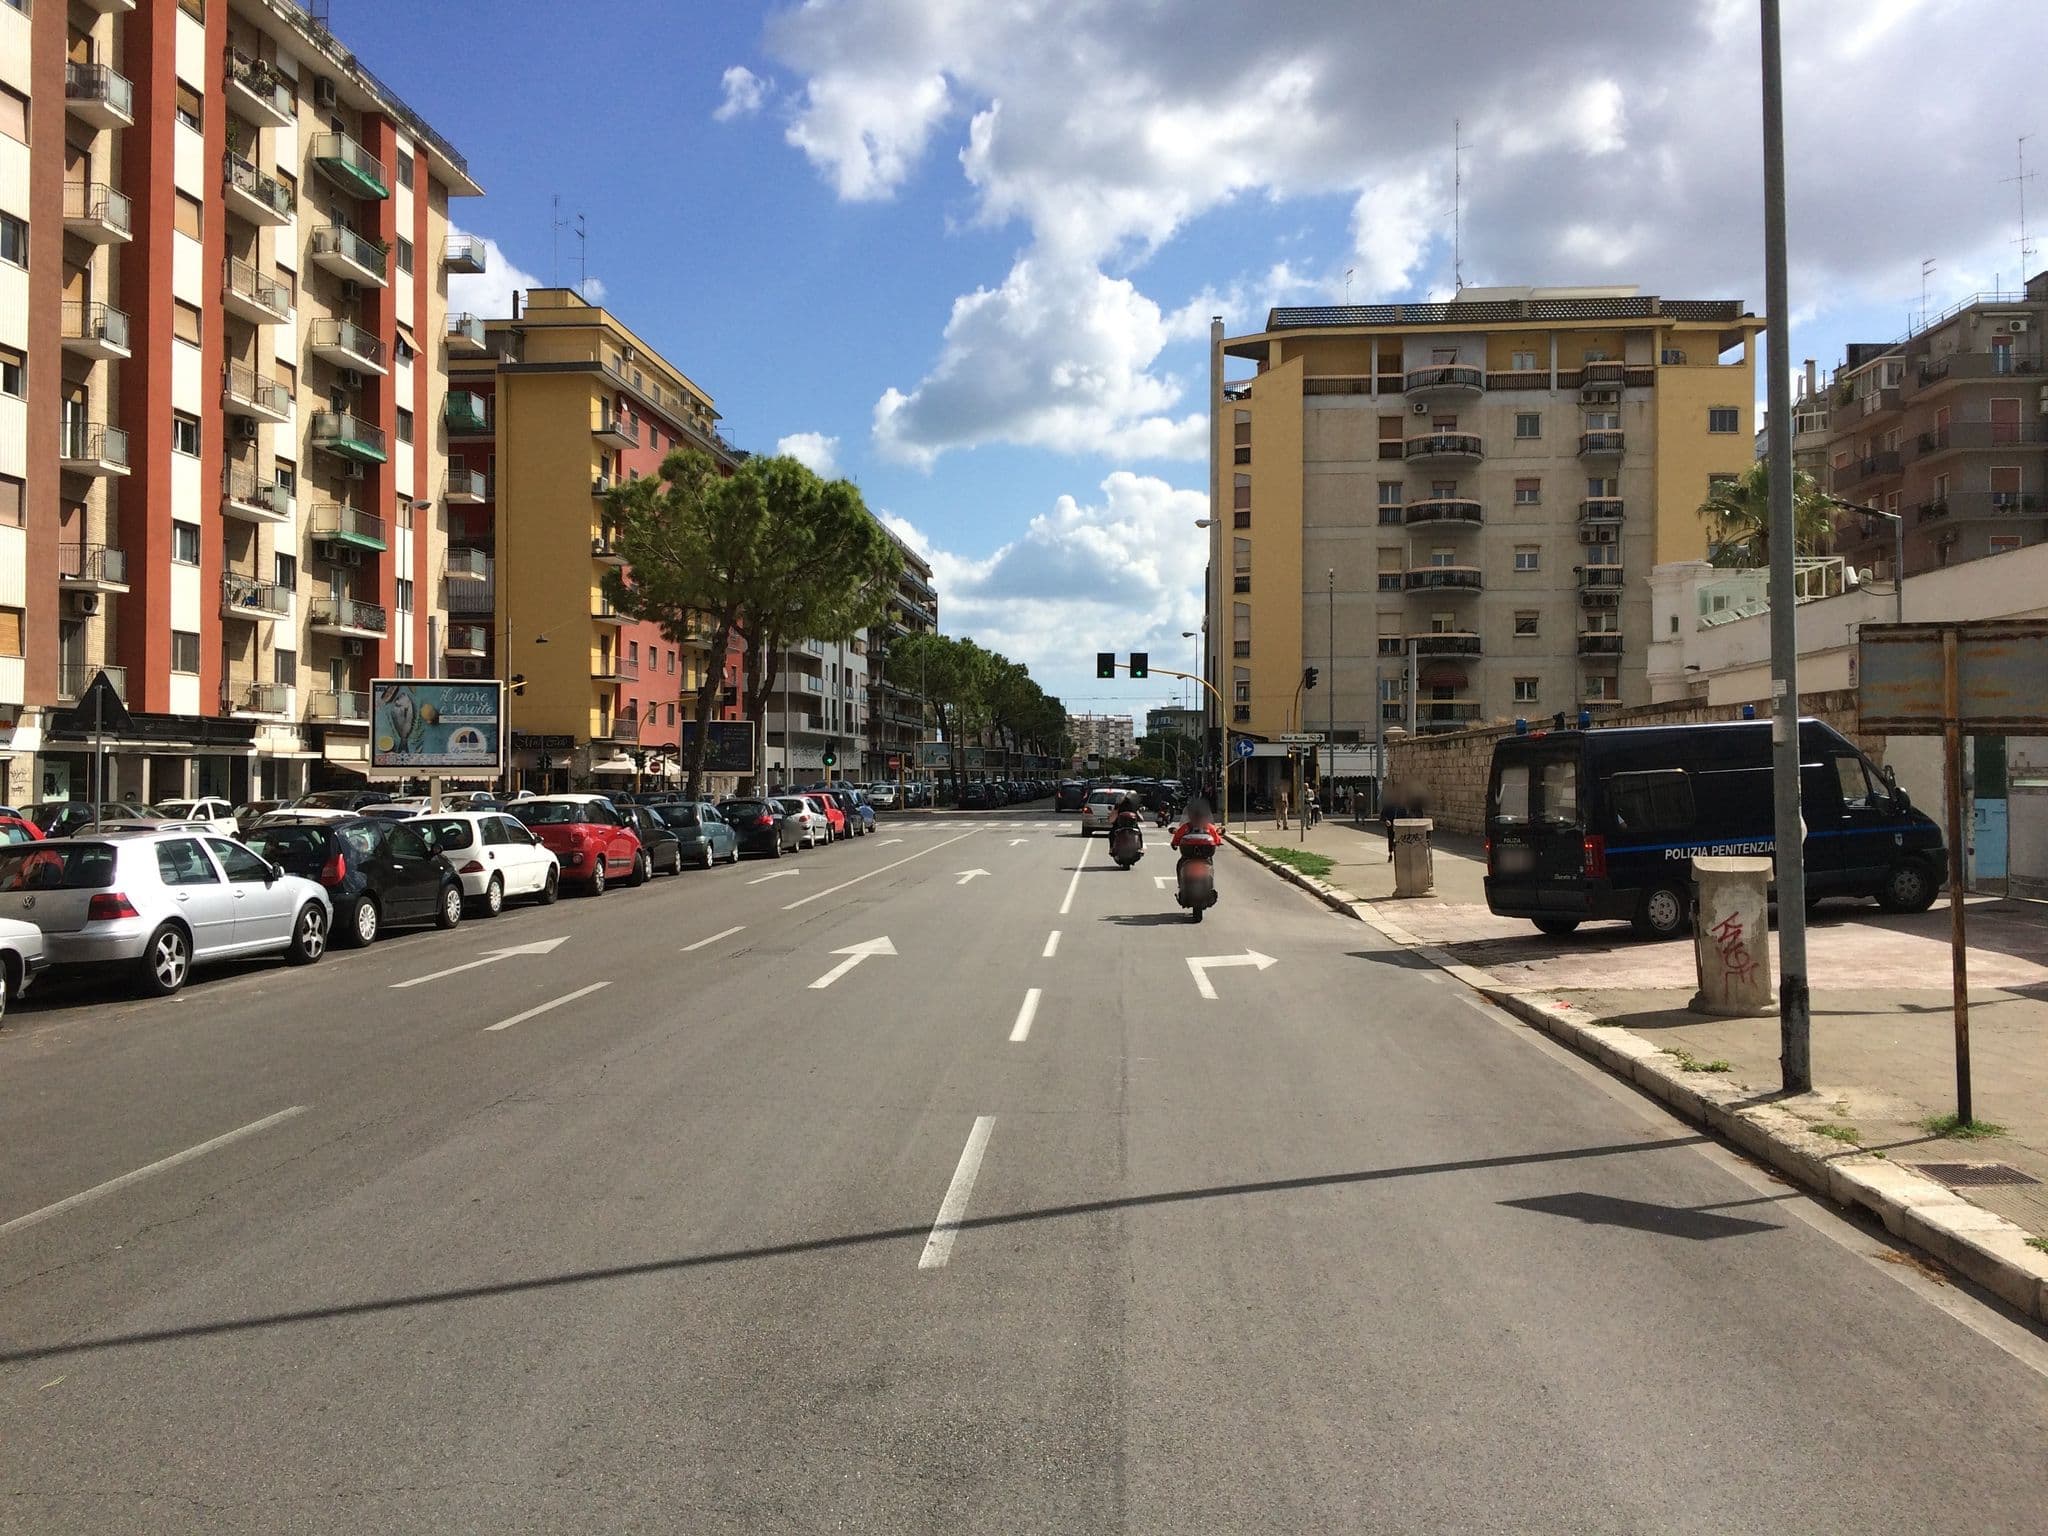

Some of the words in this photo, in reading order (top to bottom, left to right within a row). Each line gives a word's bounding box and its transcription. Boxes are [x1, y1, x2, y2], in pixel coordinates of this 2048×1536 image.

[453, 692, 488, 702] mare
[1665, 846, 1708, 860] POLIZIA
[1711, 841, 1776, 856] PENITENZIA
